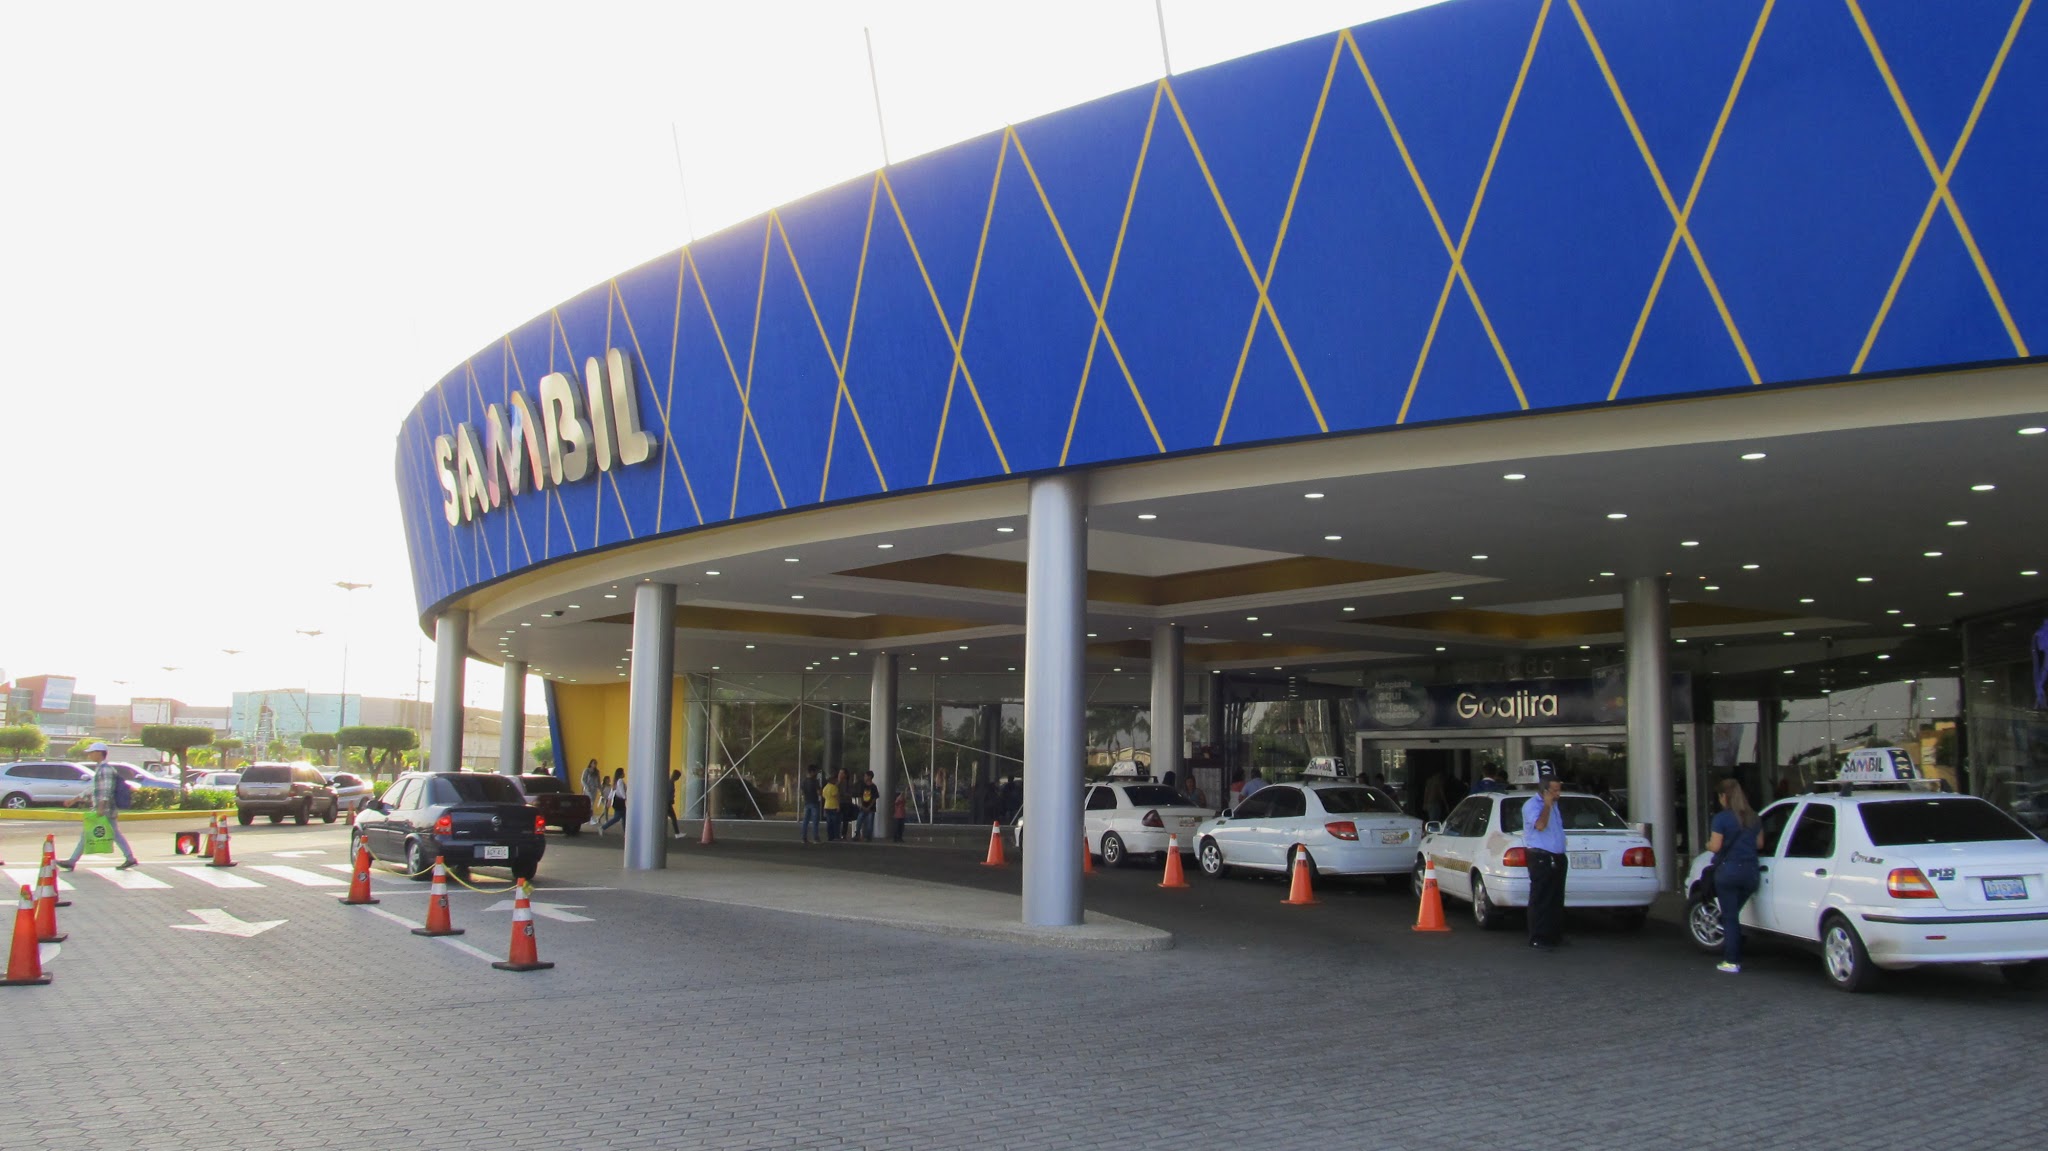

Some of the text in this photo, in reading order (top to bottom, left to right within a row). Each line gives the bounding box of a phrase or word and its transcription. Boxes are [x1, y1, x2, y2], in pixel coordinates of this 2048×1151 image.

[435, 348, 656, 526] SAMBIL
[1456, 690, 1558, 724] Goajira
[1844, 757, 1884, 773] SAMBIL
